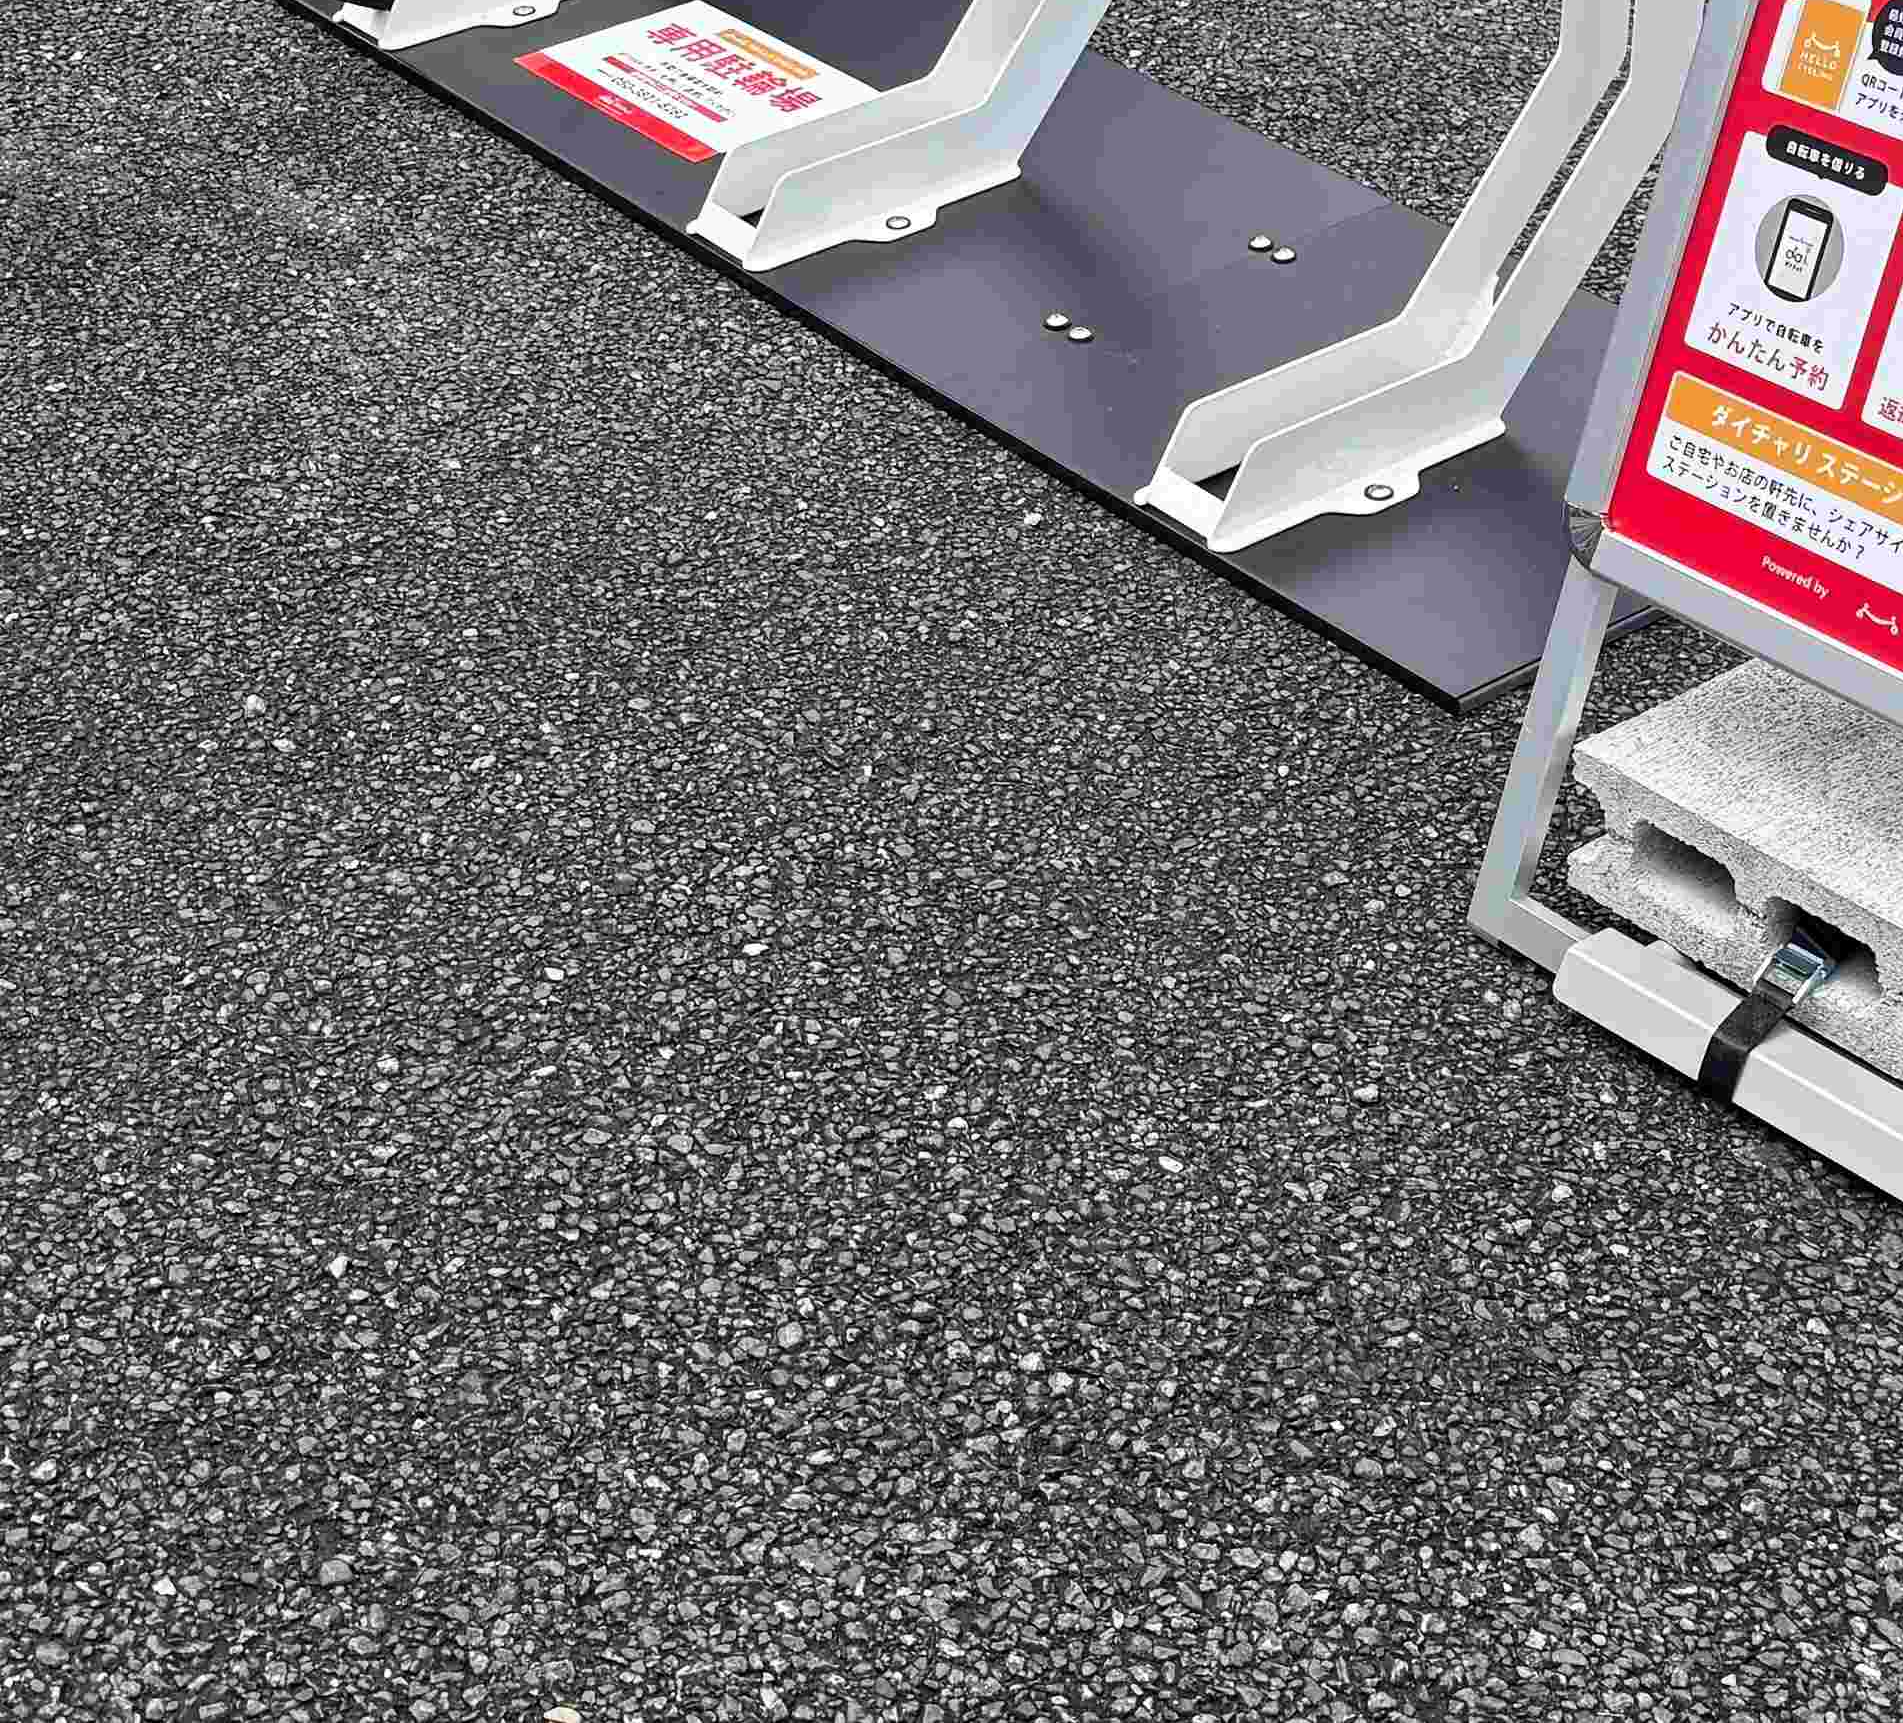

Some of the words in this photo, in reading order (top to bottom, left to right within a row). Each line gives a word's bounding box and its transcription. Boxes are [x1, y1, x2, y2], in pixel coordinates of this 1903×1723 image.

[647, 22, 823, 112] 専用駐輪場
[1786, 140, 1865, 180] 自転車を借りる
[1707, 321, 1830, 392] かんたん予約
[1727, 301, 1825, 355] アプリで自転車を
[1711, 404, 1813, 465] ダイチャリ
[1761, 555, 1814, 589] Powered
[1813, 577, 1831, 601] by
